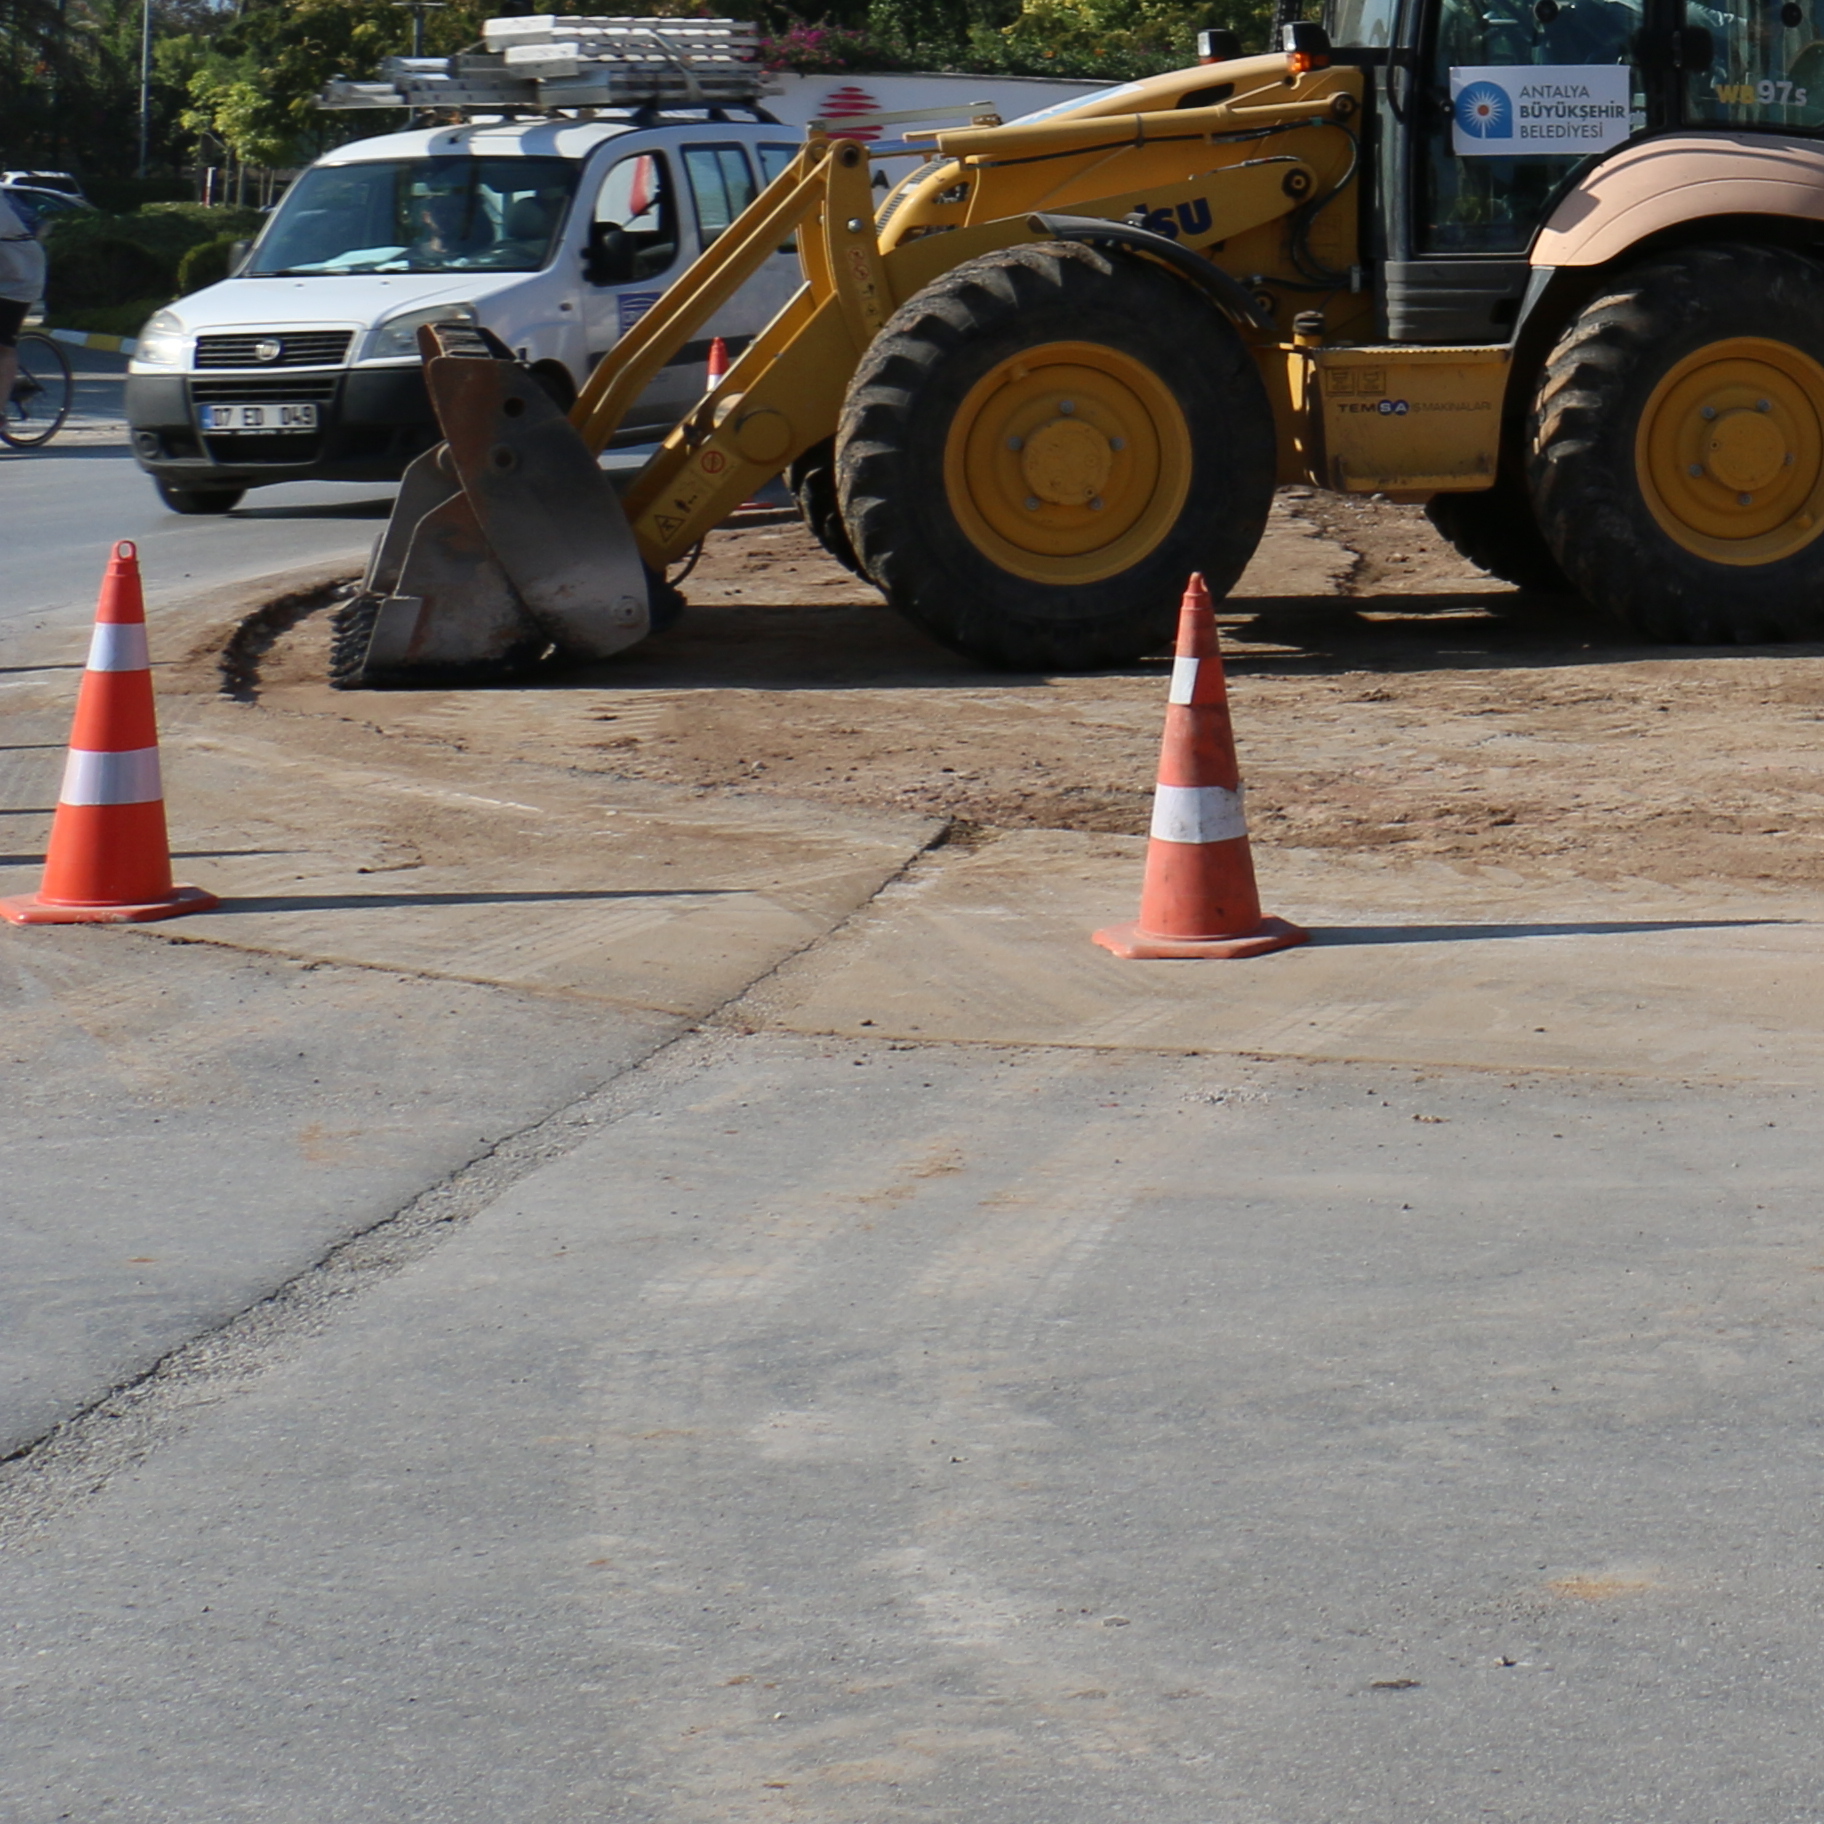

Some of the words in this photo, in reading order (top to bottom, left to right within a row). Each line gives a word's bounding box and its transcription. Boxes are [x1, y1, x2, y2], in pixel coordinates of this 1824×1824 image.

[1519, 85, 1590, 99] ANTALYA
[1520, 100, 1626, 122] BÜYÜKŞEHİR
[1520, 121, 1604, 139] BELEDİYESİ
[1337, 400, 1409, 416] TEMSA
